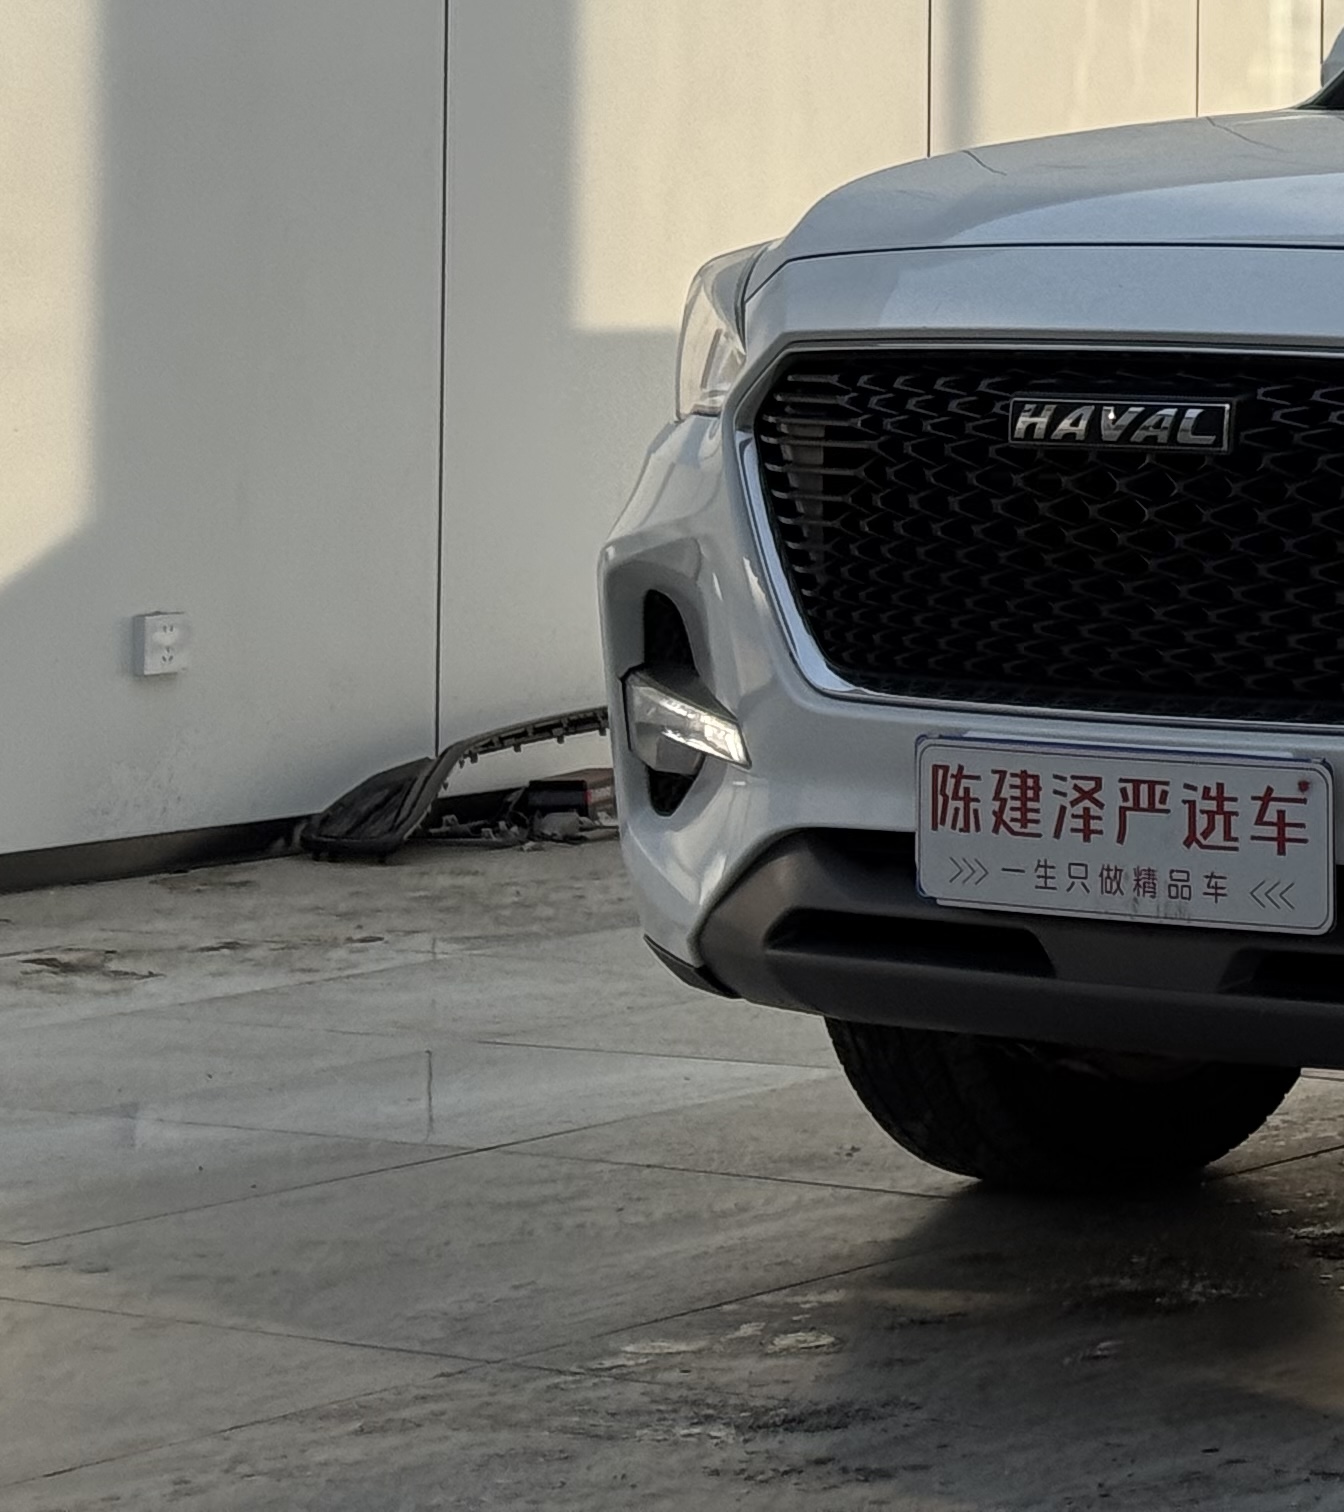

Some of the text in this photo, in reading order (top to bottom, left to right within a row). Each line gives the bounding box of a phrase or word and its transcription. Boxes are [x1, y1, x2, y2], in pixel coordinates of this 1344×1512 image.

[1013, 403, 1217, 445] HAVAL
[931, 764, 1309, 857] 陈建泽严选车
[1001, 859, 1229, 904] 一生只做精品车
